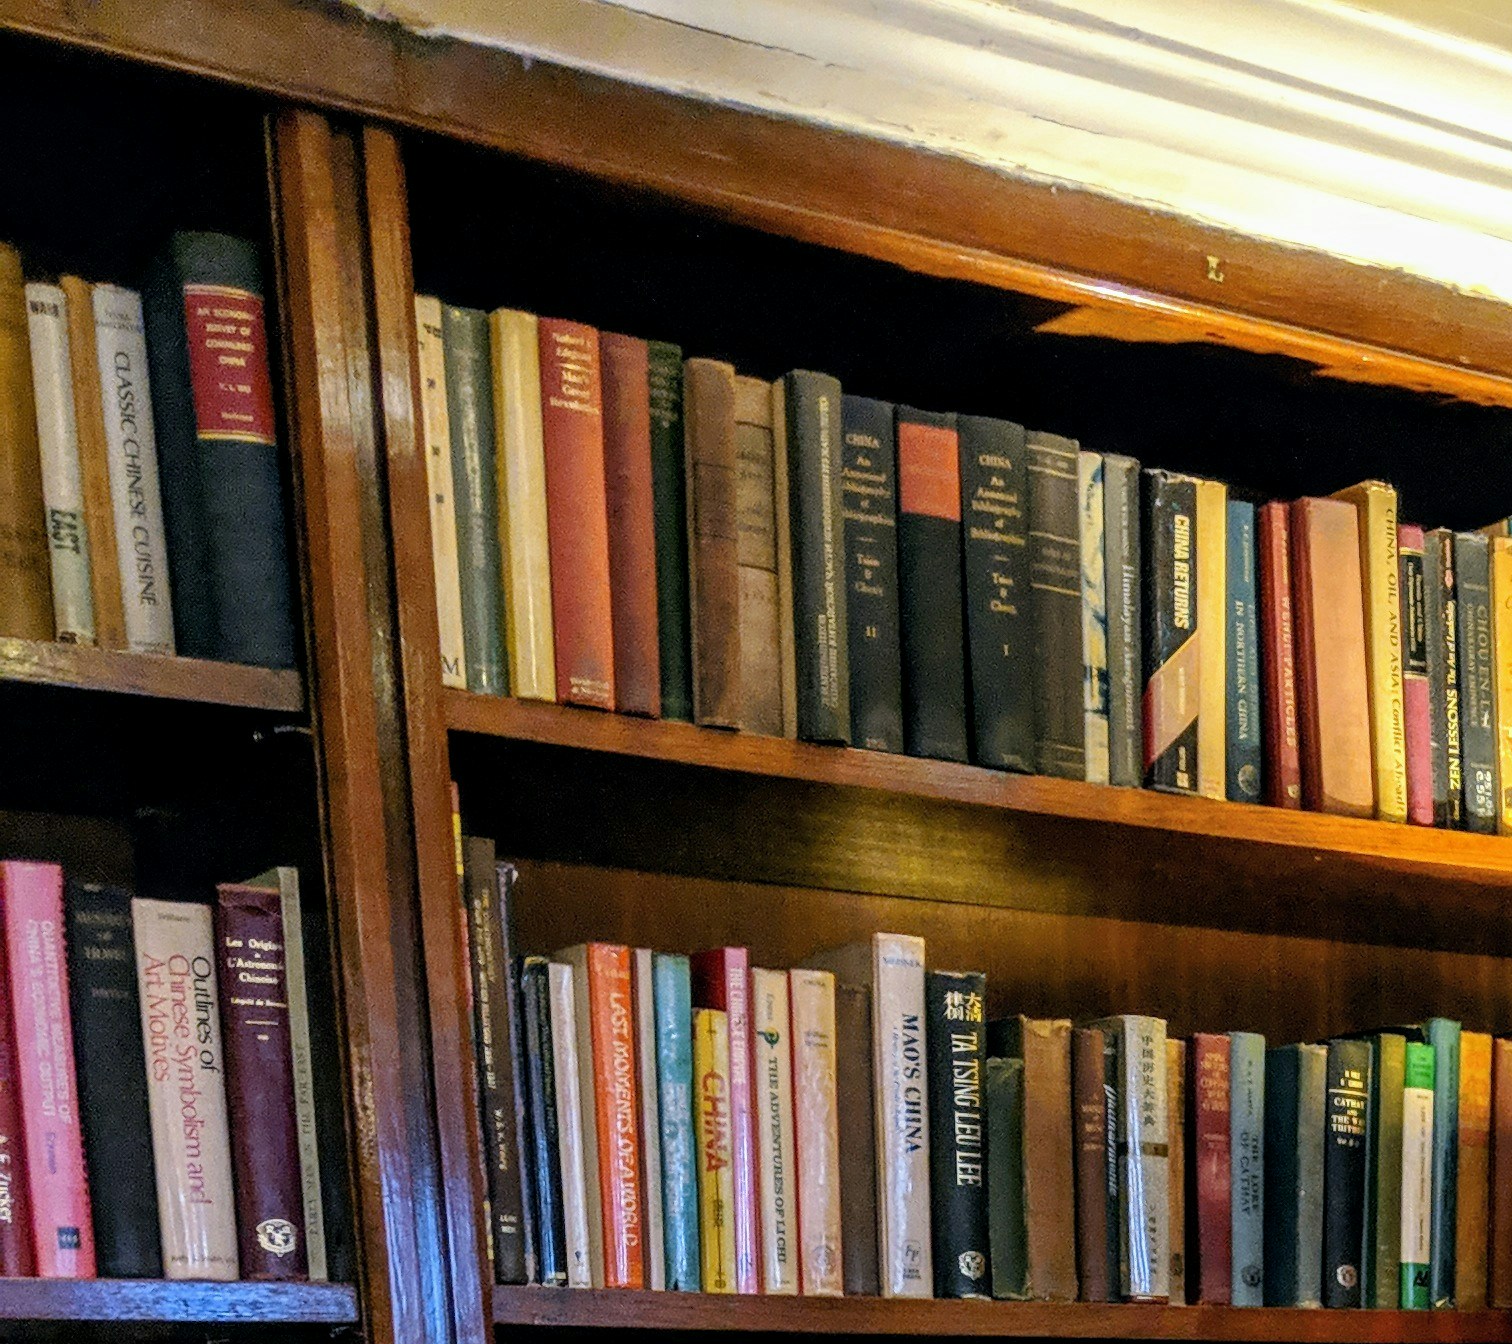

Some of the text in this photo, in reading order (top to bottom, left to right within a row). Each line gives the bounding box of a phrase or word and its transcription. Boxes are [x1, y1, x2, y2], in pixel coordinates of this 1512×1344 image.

[115, 351, 138, 435] CLASSIC
[123, 438, 146, 518] CHINESE
[978, 454, 1012, 470] CHINA
[132, 524, 156, 606] CUISINE
[1121, 564, 1134, 637] Himalayan
[1173, 514, 1190, 630] CHINA RETURNS
[1234, 601, 1248, 740] IN NORTHERN CHINA
[143, 953, 171, 1083] Art Motives
[191, 956, 220, 1074] Outlines of
[610, 992, 625, 1040] LAST
[168, 954, 212, 1205] Chinese Symbolism and
[613, 1043, 635, 1135] MOMENTS
[768, 1056, 779, 1088] THE
[902, 1013, 923, 1154] MAO'S CHINA
[950, 1031, 983, 1188] TA TSING LEU LEE
[702, 1070, 728, 1172] CHINA
[770, 1092, 785, 1194] ADVENTURES
[1331, 1114, 1350, 1124] THE
[621, 1182, 639, 1248] WORLD
[775, 1196, 785, 1218] OF
